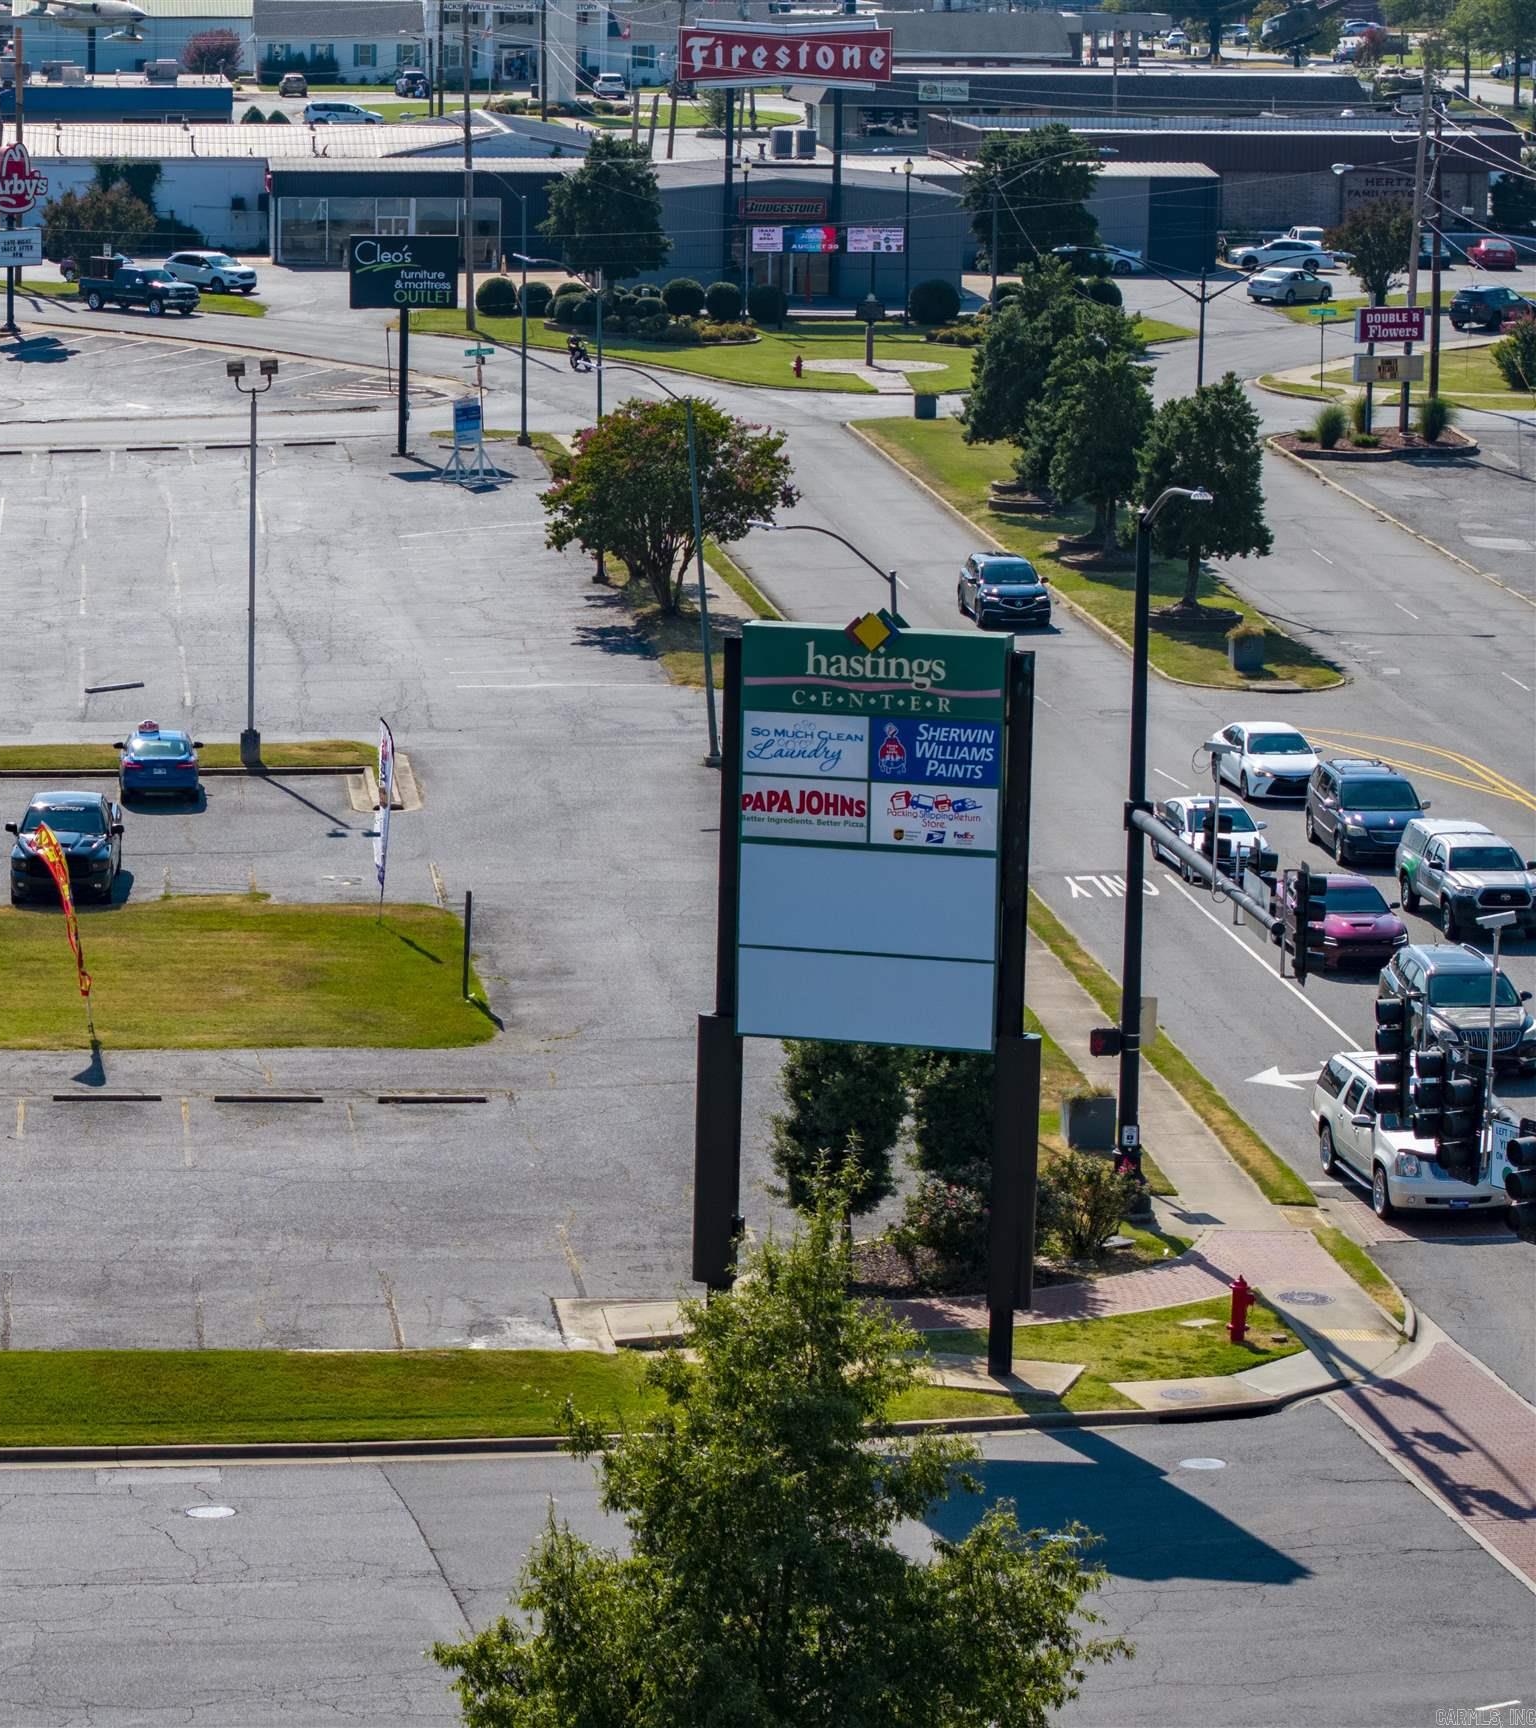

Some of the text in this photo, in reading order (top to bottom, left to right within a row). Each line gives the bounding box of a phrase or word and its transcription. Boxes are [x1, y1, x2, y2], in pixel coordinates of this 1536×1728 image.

[685, 36, 886, 73] Firestone
[745, 200, 823, 214] BRIDGESTONE
[355, 240, 413, 265] Cleo's
[400, 270, 446, 279] furniture
[404, 280, 451, 289] mattress
[393, 289, 452, 303] OUTLET
[1366, 312, 1409, 324] DOUBLE
[1367, 325, 1419, 338] Flowers
[805, 641, 946, 690] hastings
[774, 728, 814, 739] MUCH
[817, 731, 864, 742] CLEAN
[916, 723, 995, 744] SHERWIN
[746, 739, 843, 772] Laundry
[915, 741, 994, 762] WILLIAMS
[925, 760, 983, 779] PAINTS
[741, 789, 866, 818] PAPA JOHNS
[887, 808, 981, 822] Packing Shipping Return
[816, 819, 841, 827] Better
[953, 832, 975, 840] FedEx
